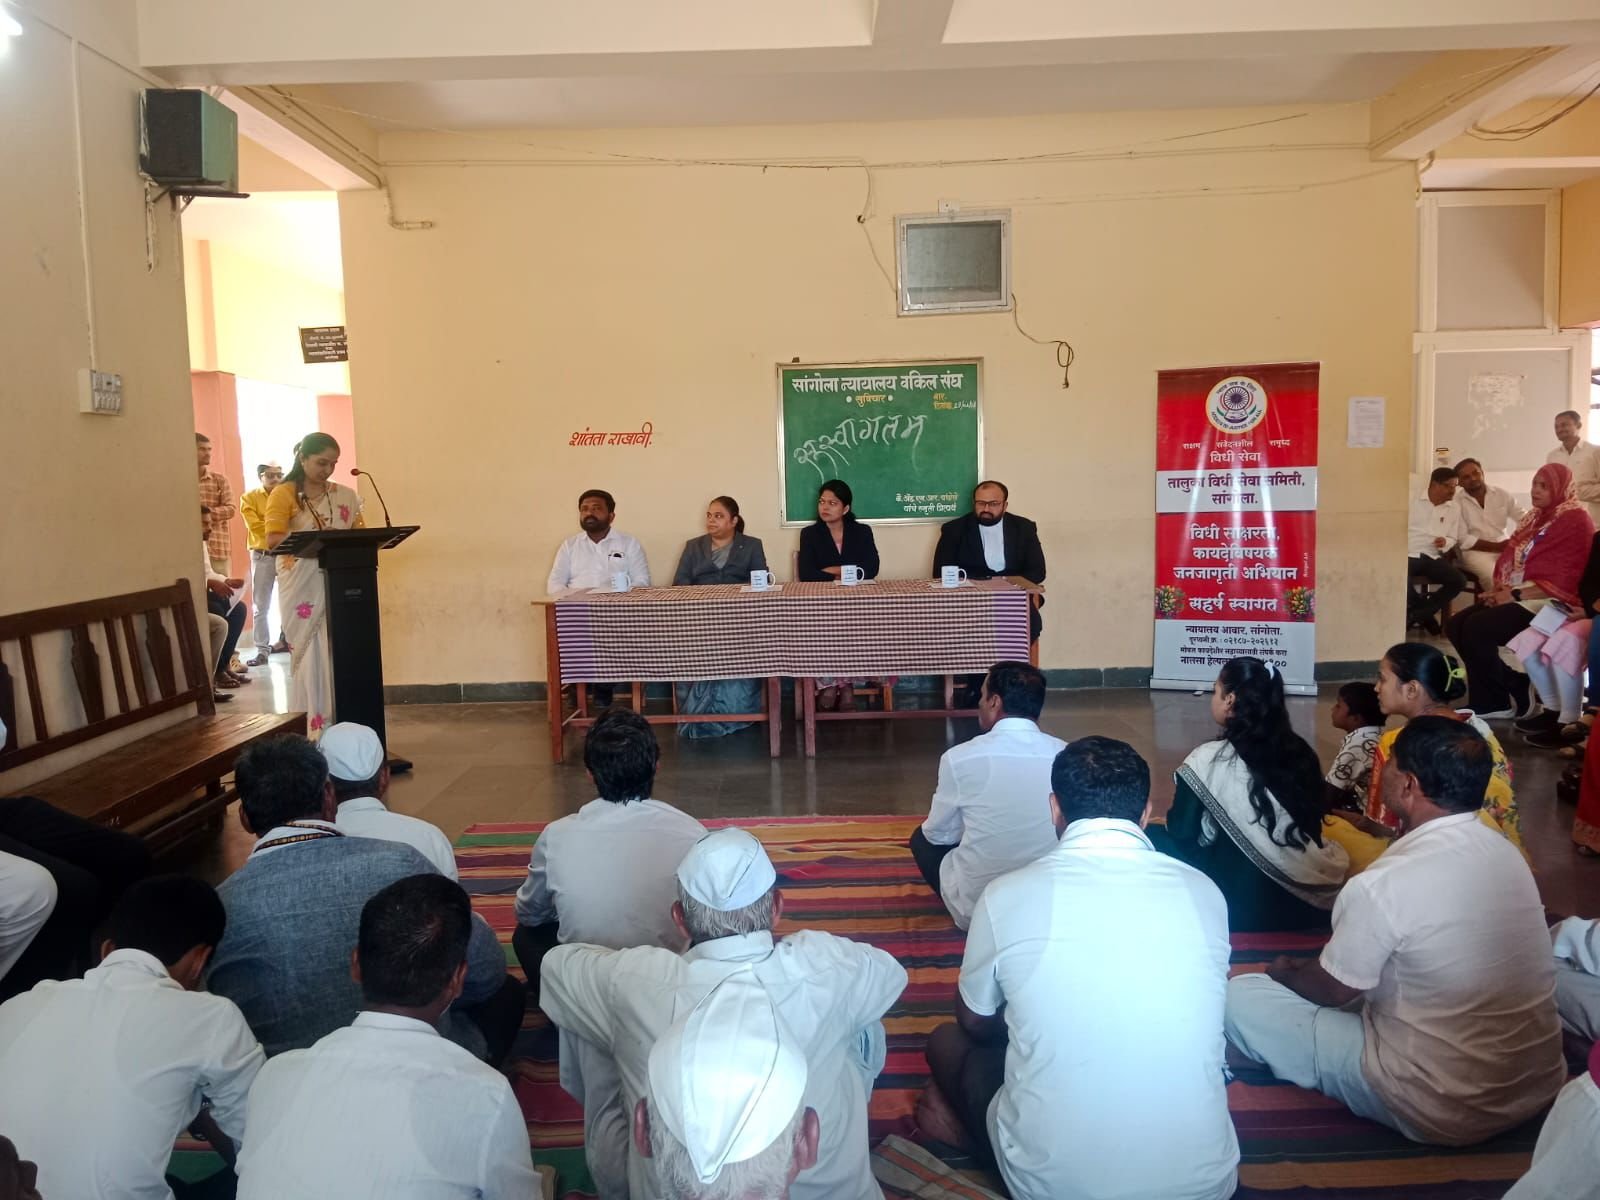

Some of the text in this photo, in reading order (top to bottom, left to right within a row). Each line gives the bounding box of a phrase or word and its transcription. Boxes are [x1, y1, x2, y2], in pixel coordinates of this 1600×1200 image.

[792, 370, 963, 392] सांगोला न्यायालय वकिल संघ
[569, 421, 653, 448] शांतता राखावी.
[1238, 449, 1261, 462] सेवा
[1190, 523, 1219, 540] विधी
[1173, 563, 1239, 584] जनजागृती
[1241, 562, 1298, 580] अभियान
[1189, 592, 1278, 614] सहर्ष स्वागत
[1185, 625, 1220, 634] न्यायालय
